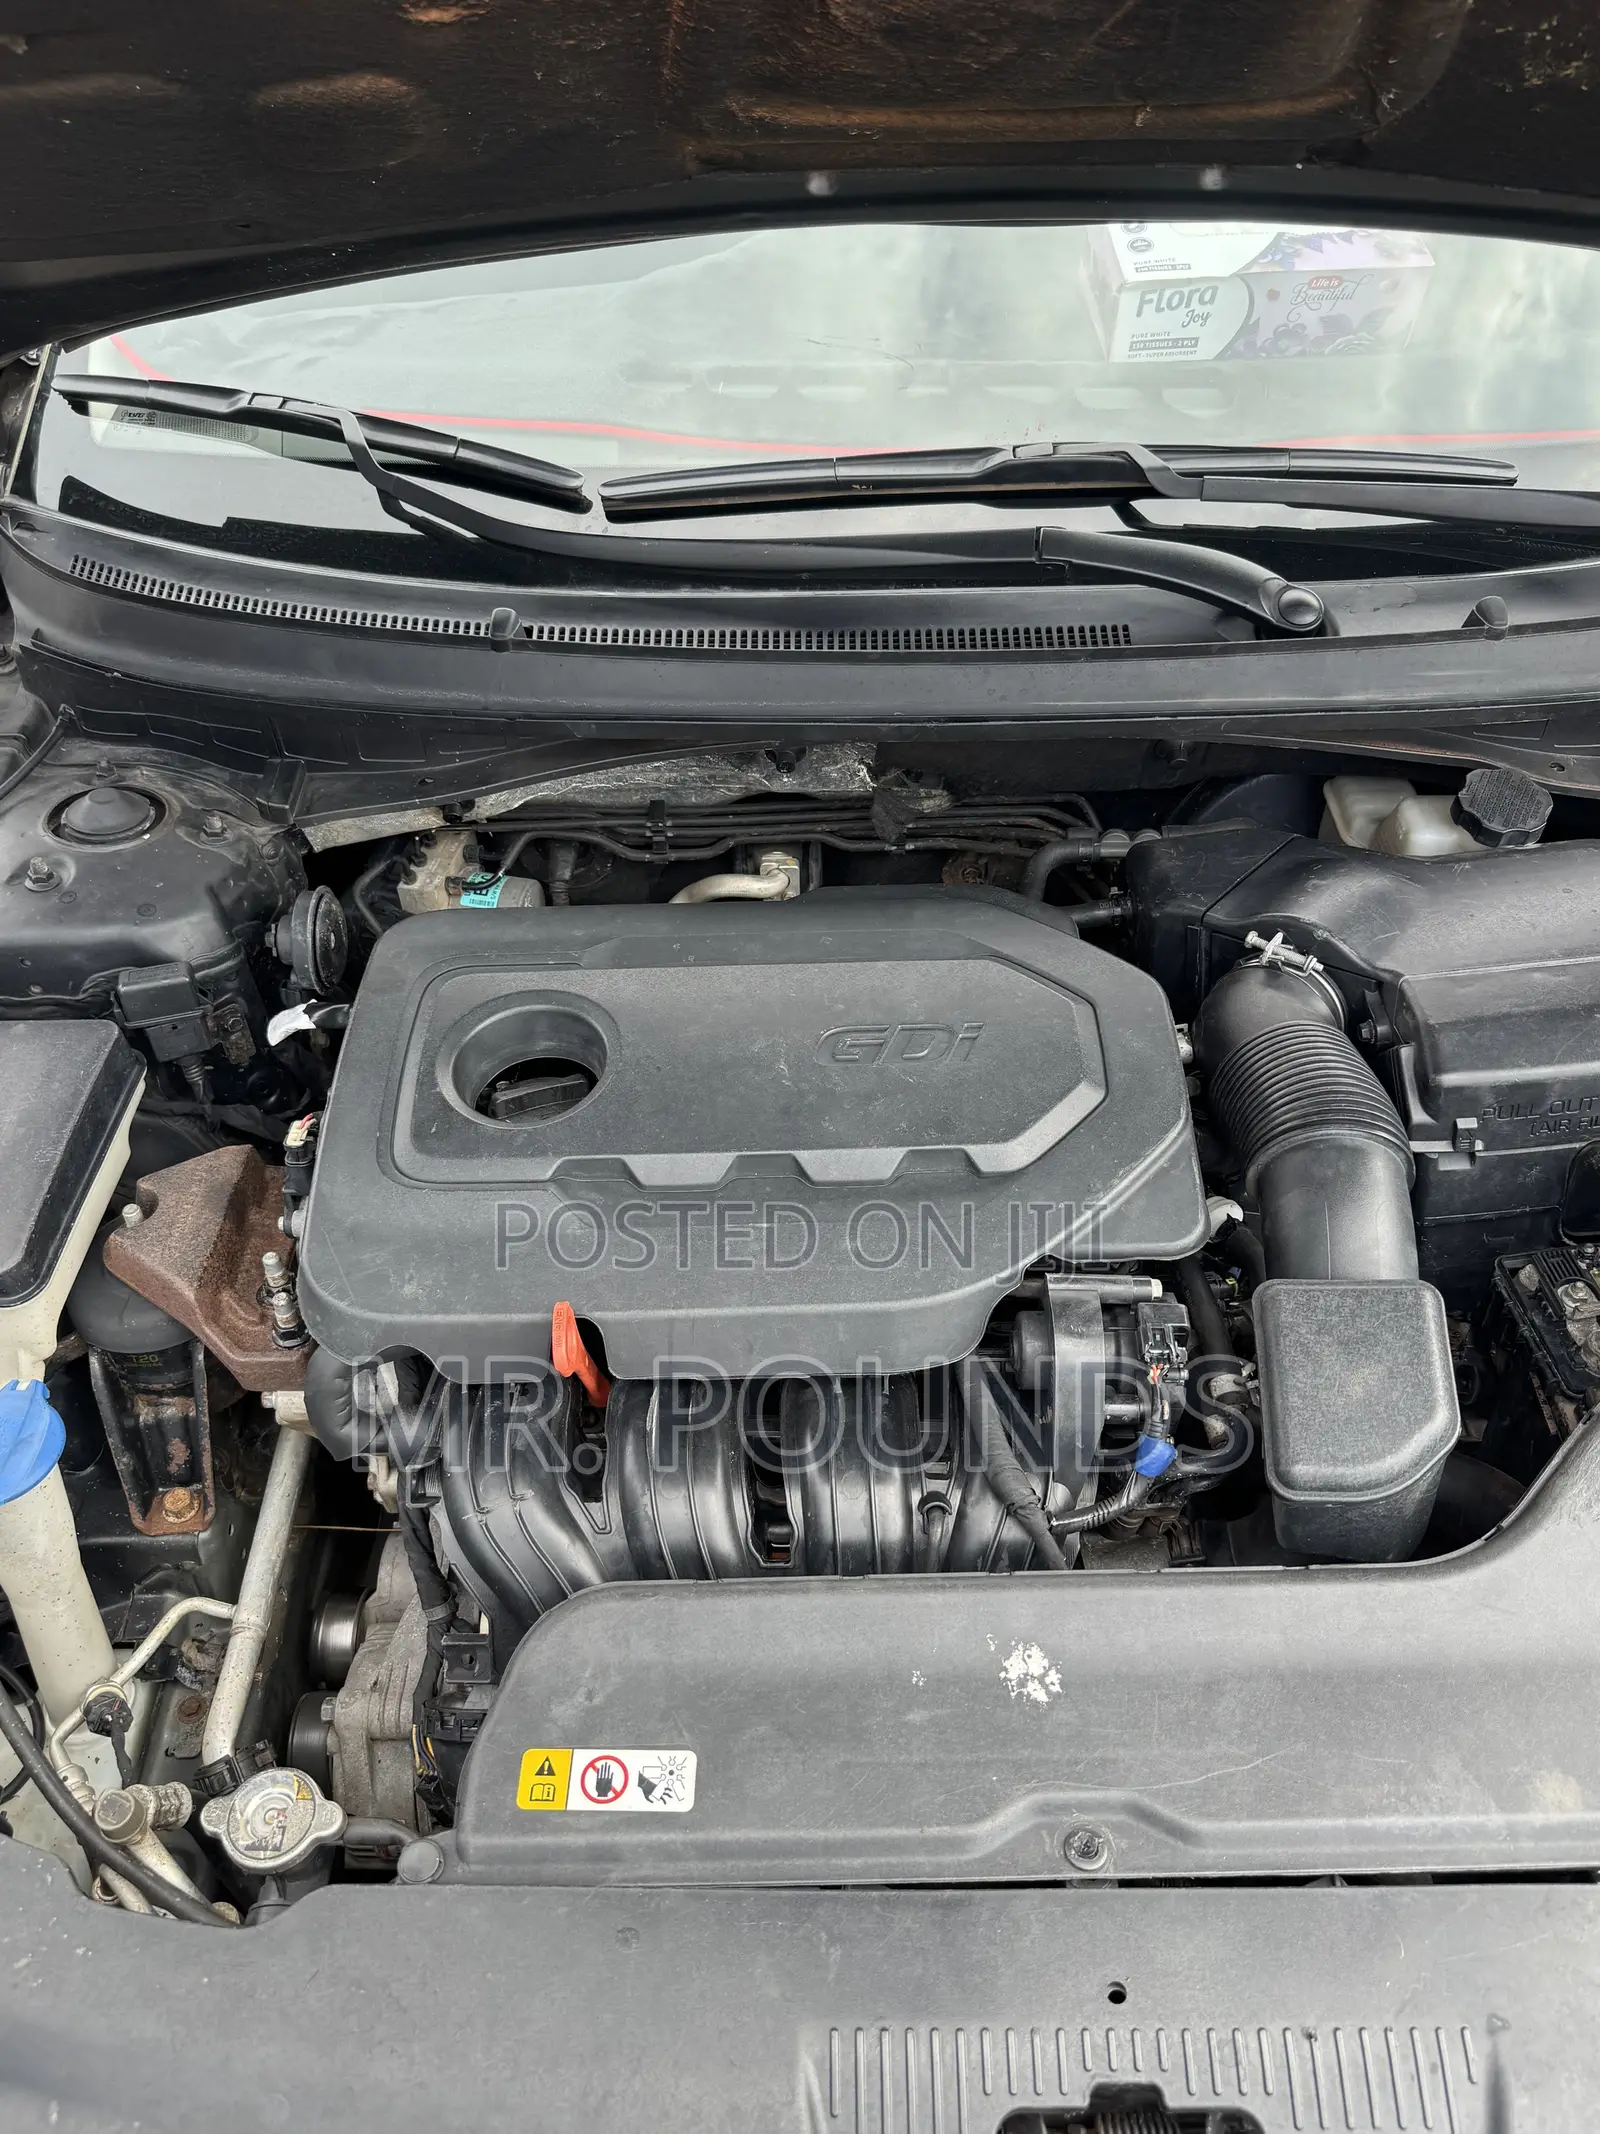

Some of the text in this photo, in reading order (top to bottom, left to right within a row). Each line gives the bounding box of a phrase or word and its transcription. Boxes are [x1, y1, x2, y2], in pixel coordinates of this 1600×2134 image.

[1311, 278, 1329, 287] Life
[1136, 285, 1219, 318] Flora
[1288, 274, 1374, 315] Beautiful
[1181, 308, 1212, 328] Joy
[1145, 340, 1173, 348] TISSUES
[1481, 1096, 1599, 1123] PULL OUT
[127, 1354, 159, 1363] T20
